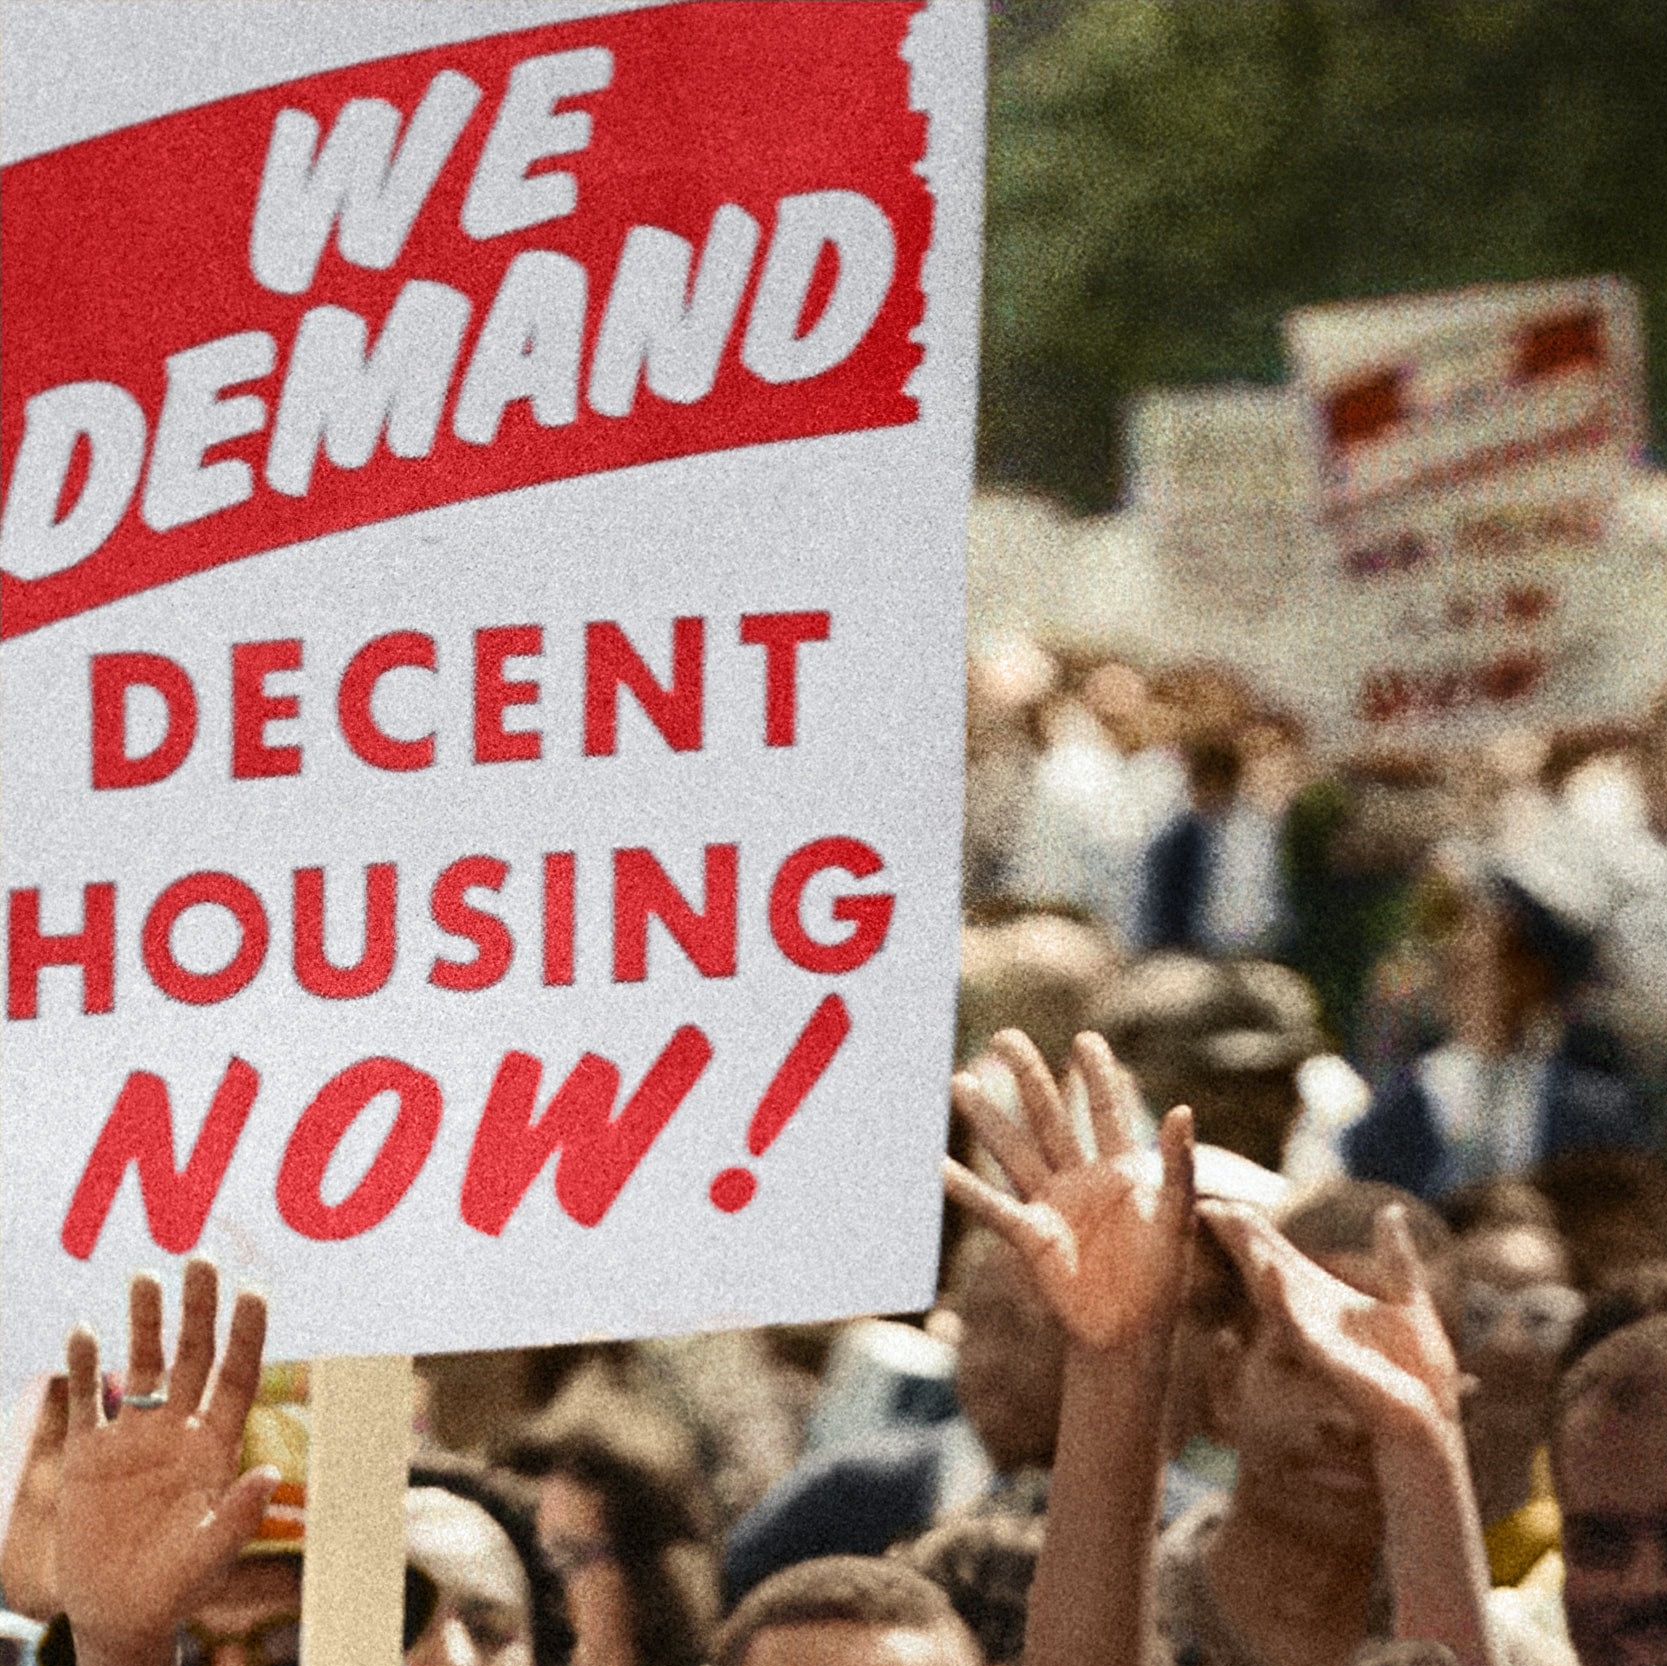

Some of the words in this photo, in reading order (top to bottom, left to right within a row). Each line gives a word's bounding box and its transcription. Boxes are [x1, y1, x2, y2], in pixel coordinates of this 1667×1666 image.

[248, 45, 614, 296] WE
[0, 187, 897, 583] DEMAND
[88, 610, 831, 791] DECENT
[6, 834, 896, 1022] HOUSING
[61, 991, 852, 1262] NOW!
